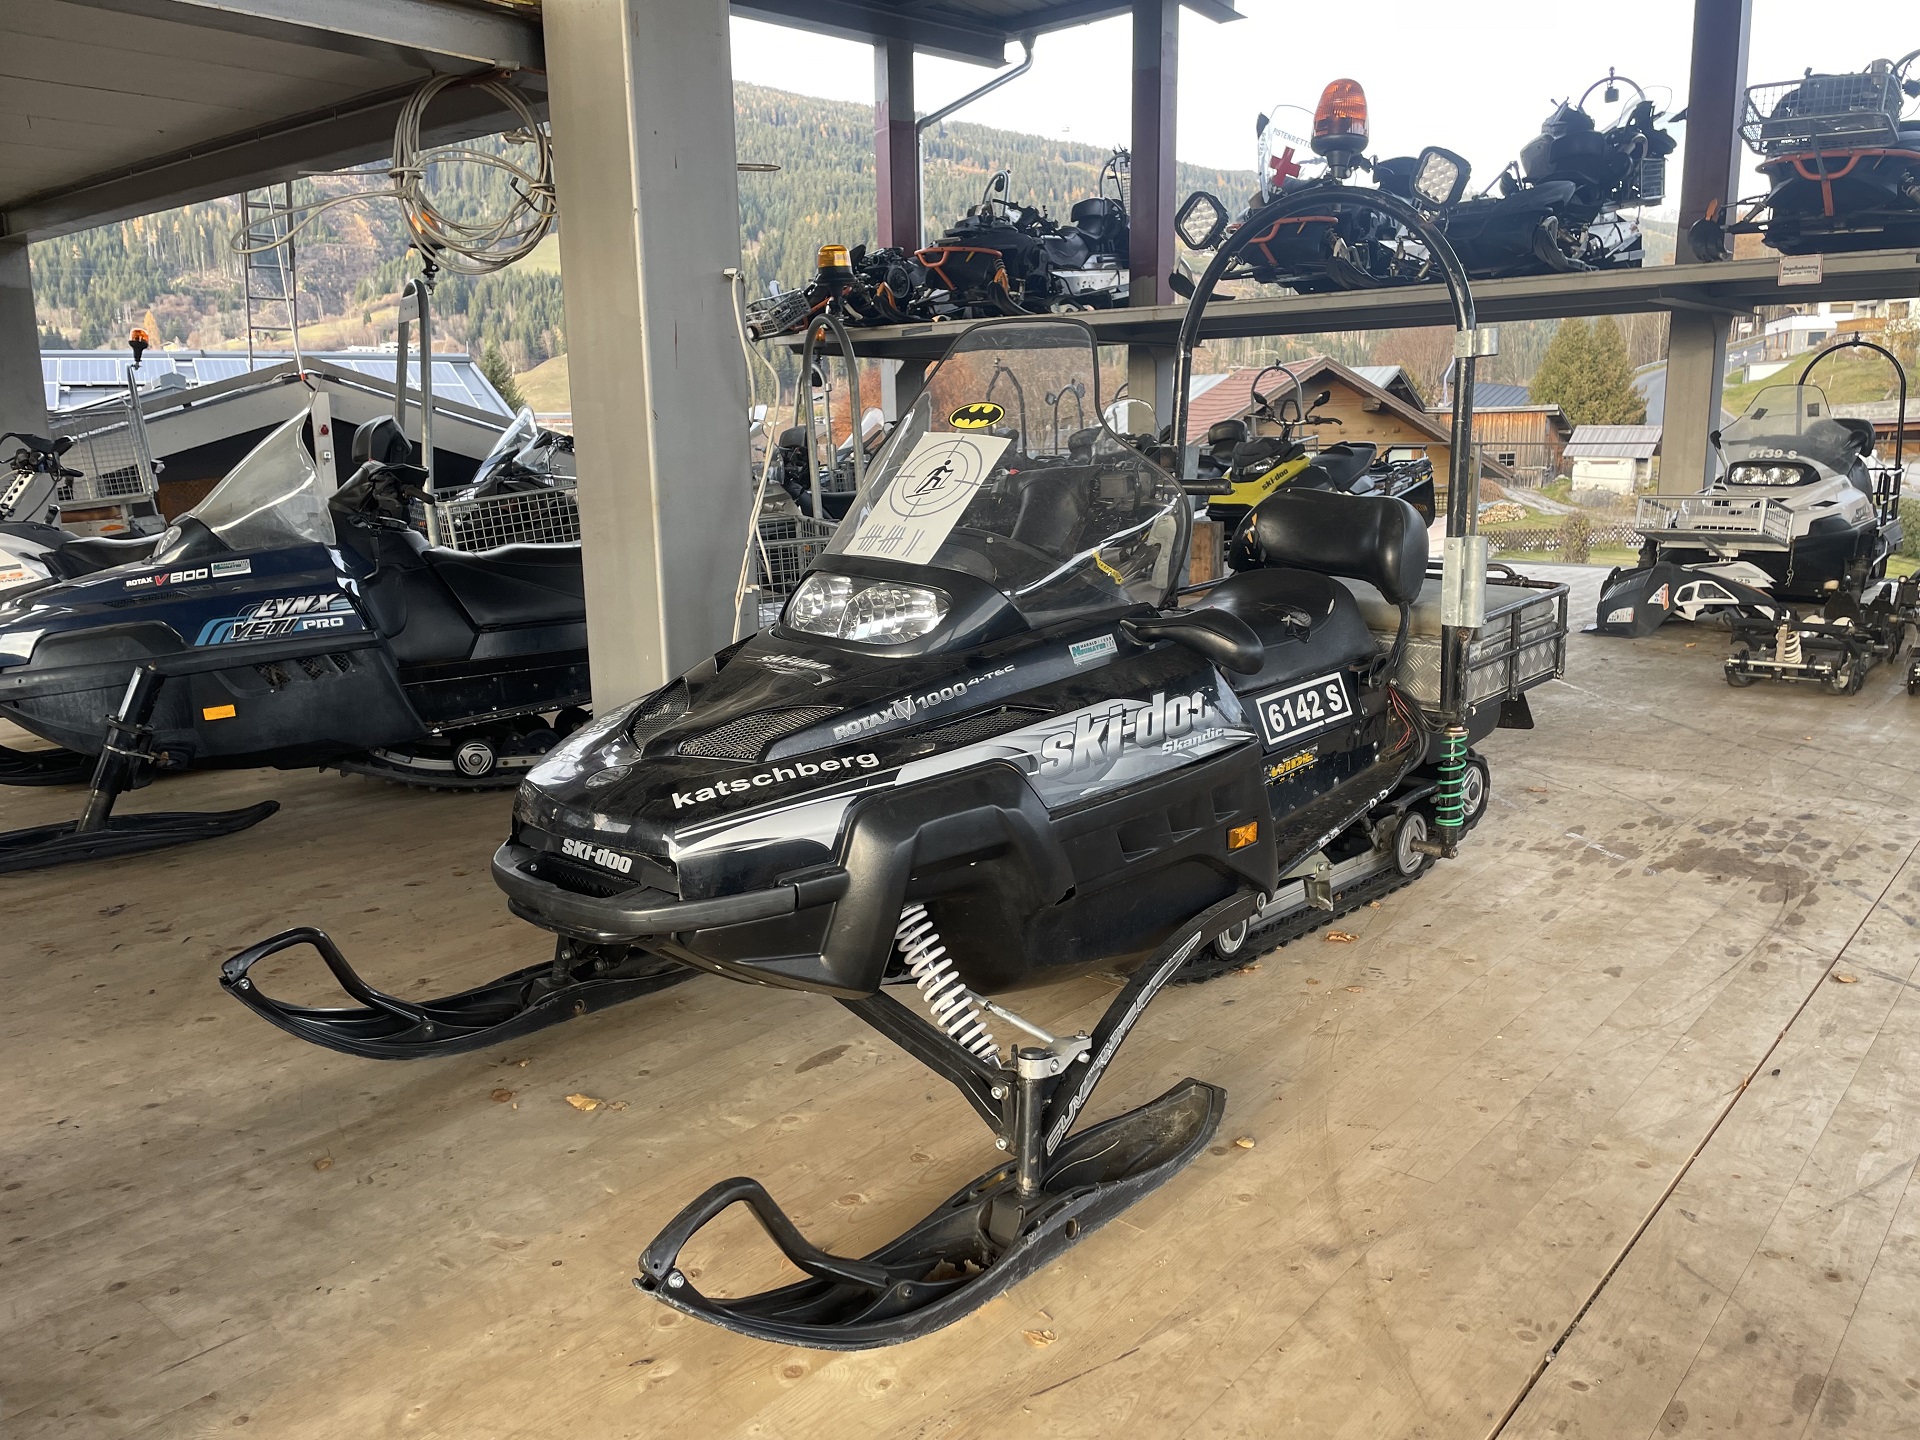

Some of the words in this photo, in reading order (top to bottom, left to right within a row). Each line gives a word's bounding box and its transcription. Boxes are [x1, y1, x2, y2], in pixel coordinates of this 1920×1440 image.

[1749, 448, 1783, 459] 6139
[1787, 450, 1798, 460] S
[126, 576, 153, 587] ROTAX
[255, 593, 340, 618] LYNX
[231, 616, 300, 639] YETI
[302, 617, 344, 630] PRO
[833, 707, 897, 741] ROTAX
[916, 682, 968, 709] 1000
[1268, 690, 1325, 732] 6142
[1325, 684, 1343, 711] S
[1161, 728, 1224, 755] Skandic
[671, 752, 880, 810] katschberg
